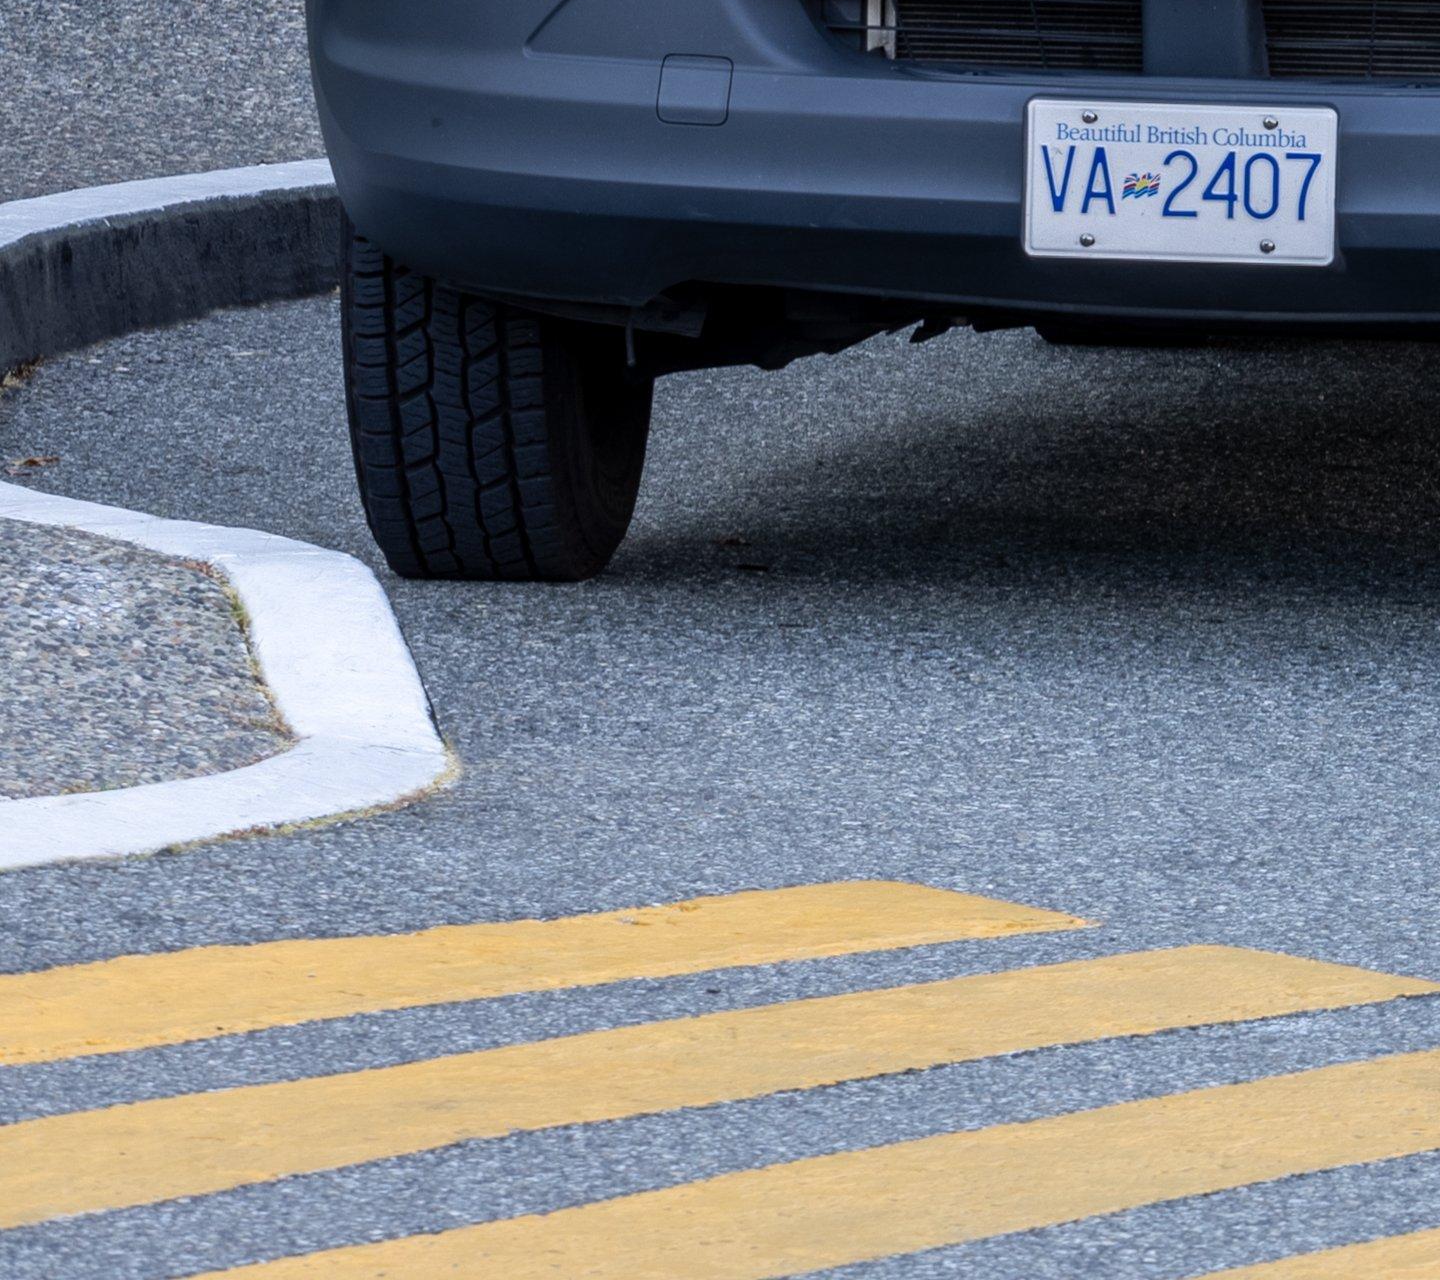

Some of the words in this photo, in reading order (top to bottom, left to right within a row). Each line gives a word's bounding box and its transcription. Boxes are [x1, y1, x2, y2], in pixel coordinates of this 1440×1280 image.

[1056, 123, 1141, 143] Beautiful
[1147, 125, 1207, 146] British
[1213, 128, 1307, 148] Columbia
[1041, 145, 1116, 215] VA
[1162, 150, 1322, 221] 2407
